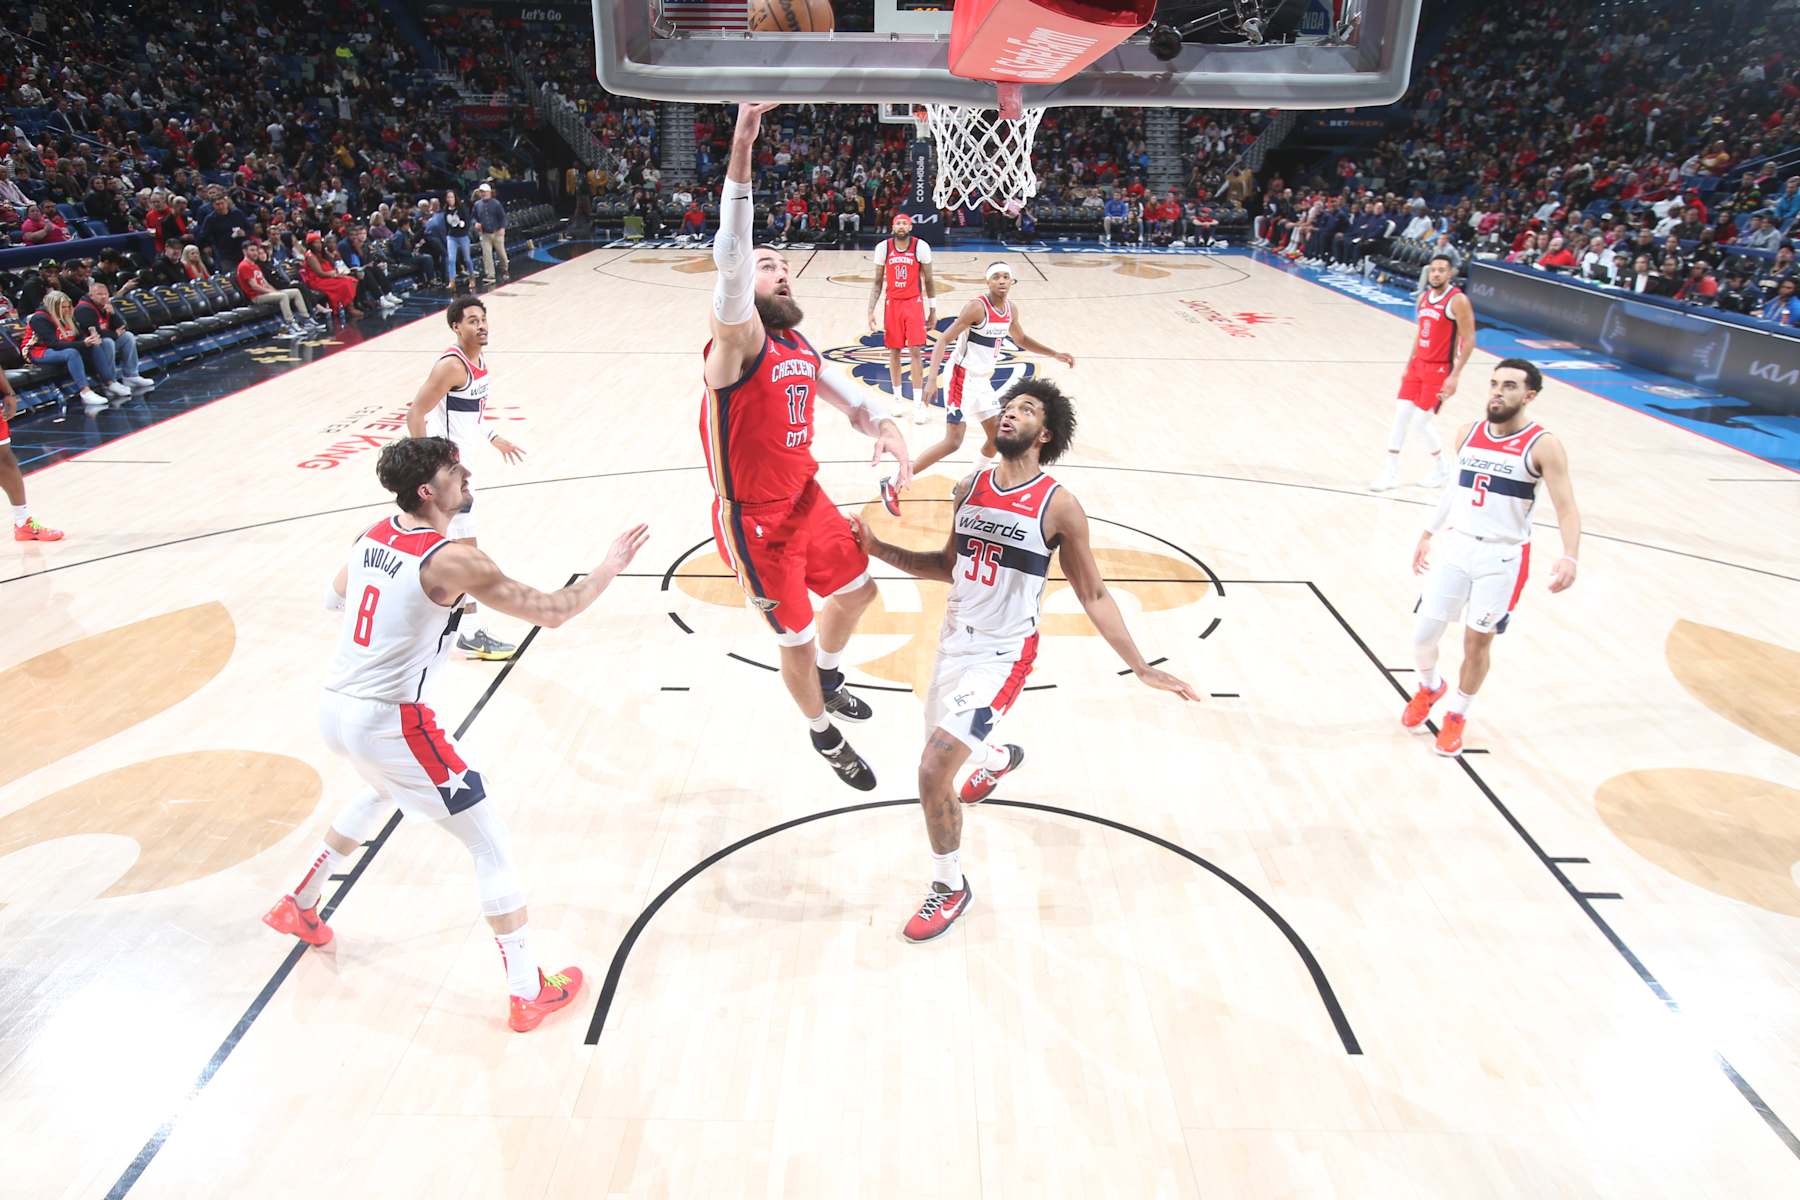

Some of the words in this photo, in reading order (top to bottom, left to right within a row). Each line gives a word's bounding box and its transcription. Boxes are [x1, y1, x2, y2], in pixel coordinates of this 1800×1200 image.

[521, 8, 545, 21] Let's
[547, 9, 562, 21] Go
[1302, 11, 1325, 30] NBA
[916, 156, 925, 181] Mobile
[916, 182, 925, 203] COX
[895, 265, 907, 280] 14
[771, 358, 816, 383] CRESCENT
[785, 384, 809, 425] 17
[786, 427, 808, 448] CITY
[296, 434, 395, 470] KING
[1471, 473, 1491, 508] 5
[959, 514, 1029, 542] wizards
[363, 547, 404, 579] AVDIJA
[964, 538, 1003, 587] 35
[353, 584, 380, 648] 8
